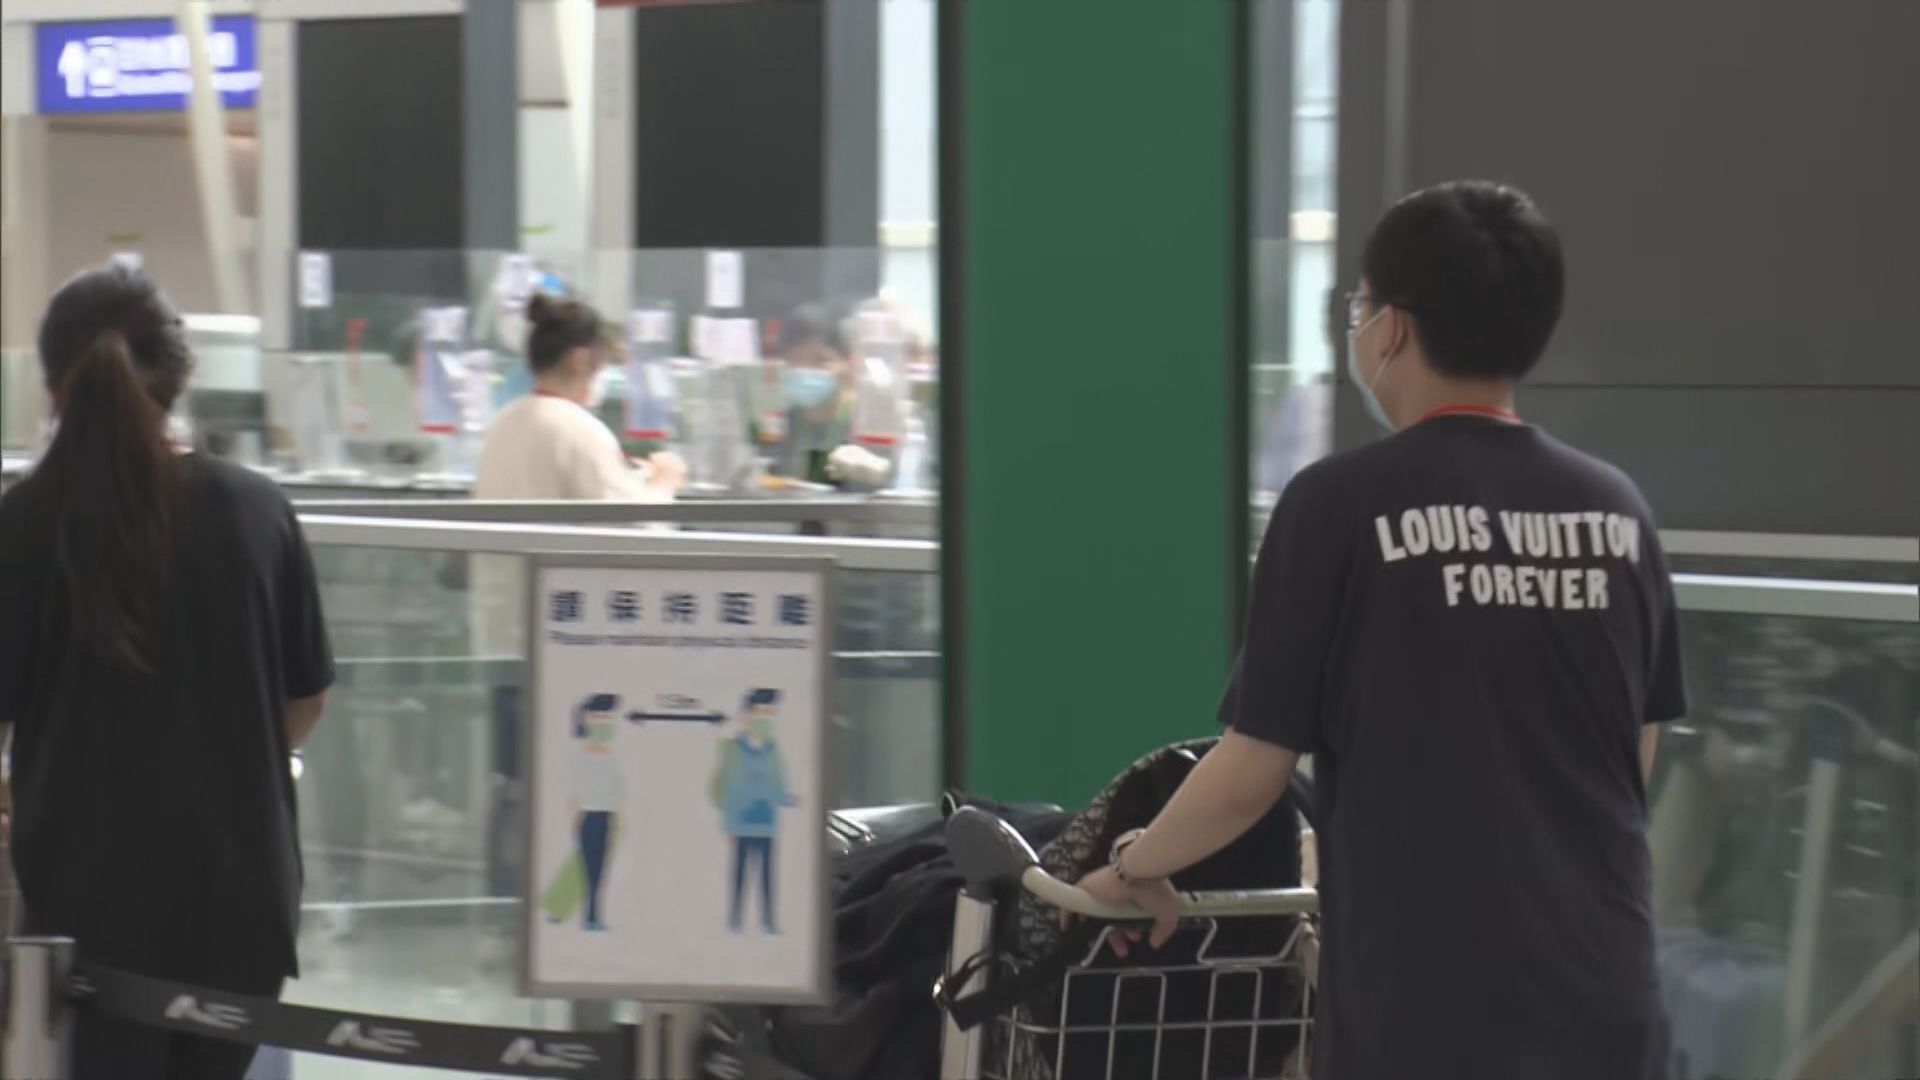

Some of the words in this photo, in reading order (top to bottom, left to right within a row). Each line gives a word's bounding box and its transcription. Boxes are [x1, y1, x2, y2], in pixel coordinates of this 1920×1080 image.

[1375, 505, 1493, 562] LOUIS
[1499, 511, 1640, 563] VUITTON
[1443, 564, 1609, 609] FOREVER
